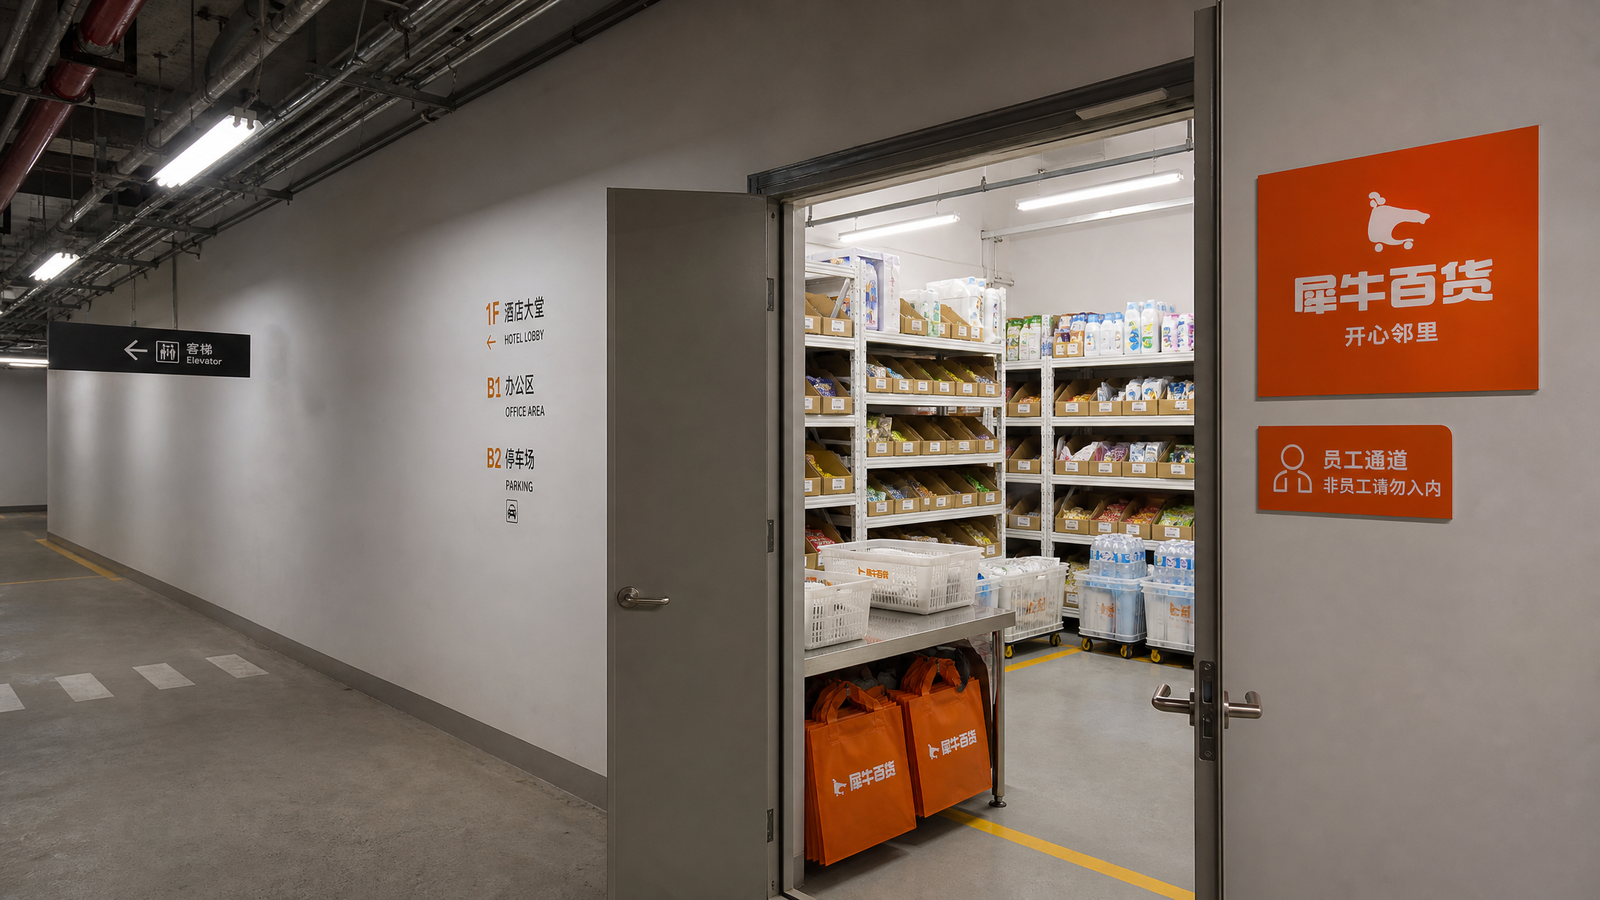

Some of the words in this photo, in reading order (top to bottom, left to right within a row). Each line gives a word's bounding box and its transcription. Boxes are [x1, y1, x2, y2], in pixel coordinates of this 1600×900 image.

[1294, 258, 1493, 314] 犀牛百货
[486, 301, 500, 325] 1F
[504, 296, 544, 323] 酒店大堂
[504, 332, 523, 345] HOTEL
[524, 329, 545, 343] LOBBY
[1344, 321, 1438, 347] 开心邻里
[187, 342, 213, 355] 客梯
[187, 356, 222, 365] Elevator
[487, 376, 501, 398] B1
[505, 374, 535, 397] 办公区
[505, 406, 526, 417] OFFICE
[527, 405, 545, 417] AREA
[487, 448, 501, 469] B2
[505, 448, 535, 470] 停车场
[1323, 449, 1408, 471] 员工通道
[505, 480, 534, 493] PARKING
[1323, 476, 1442, 498] 非员工请勿入内
[940, 729, 977, 756] 犀牛百货
[849, 760, 896, 791] 犀牛百货
